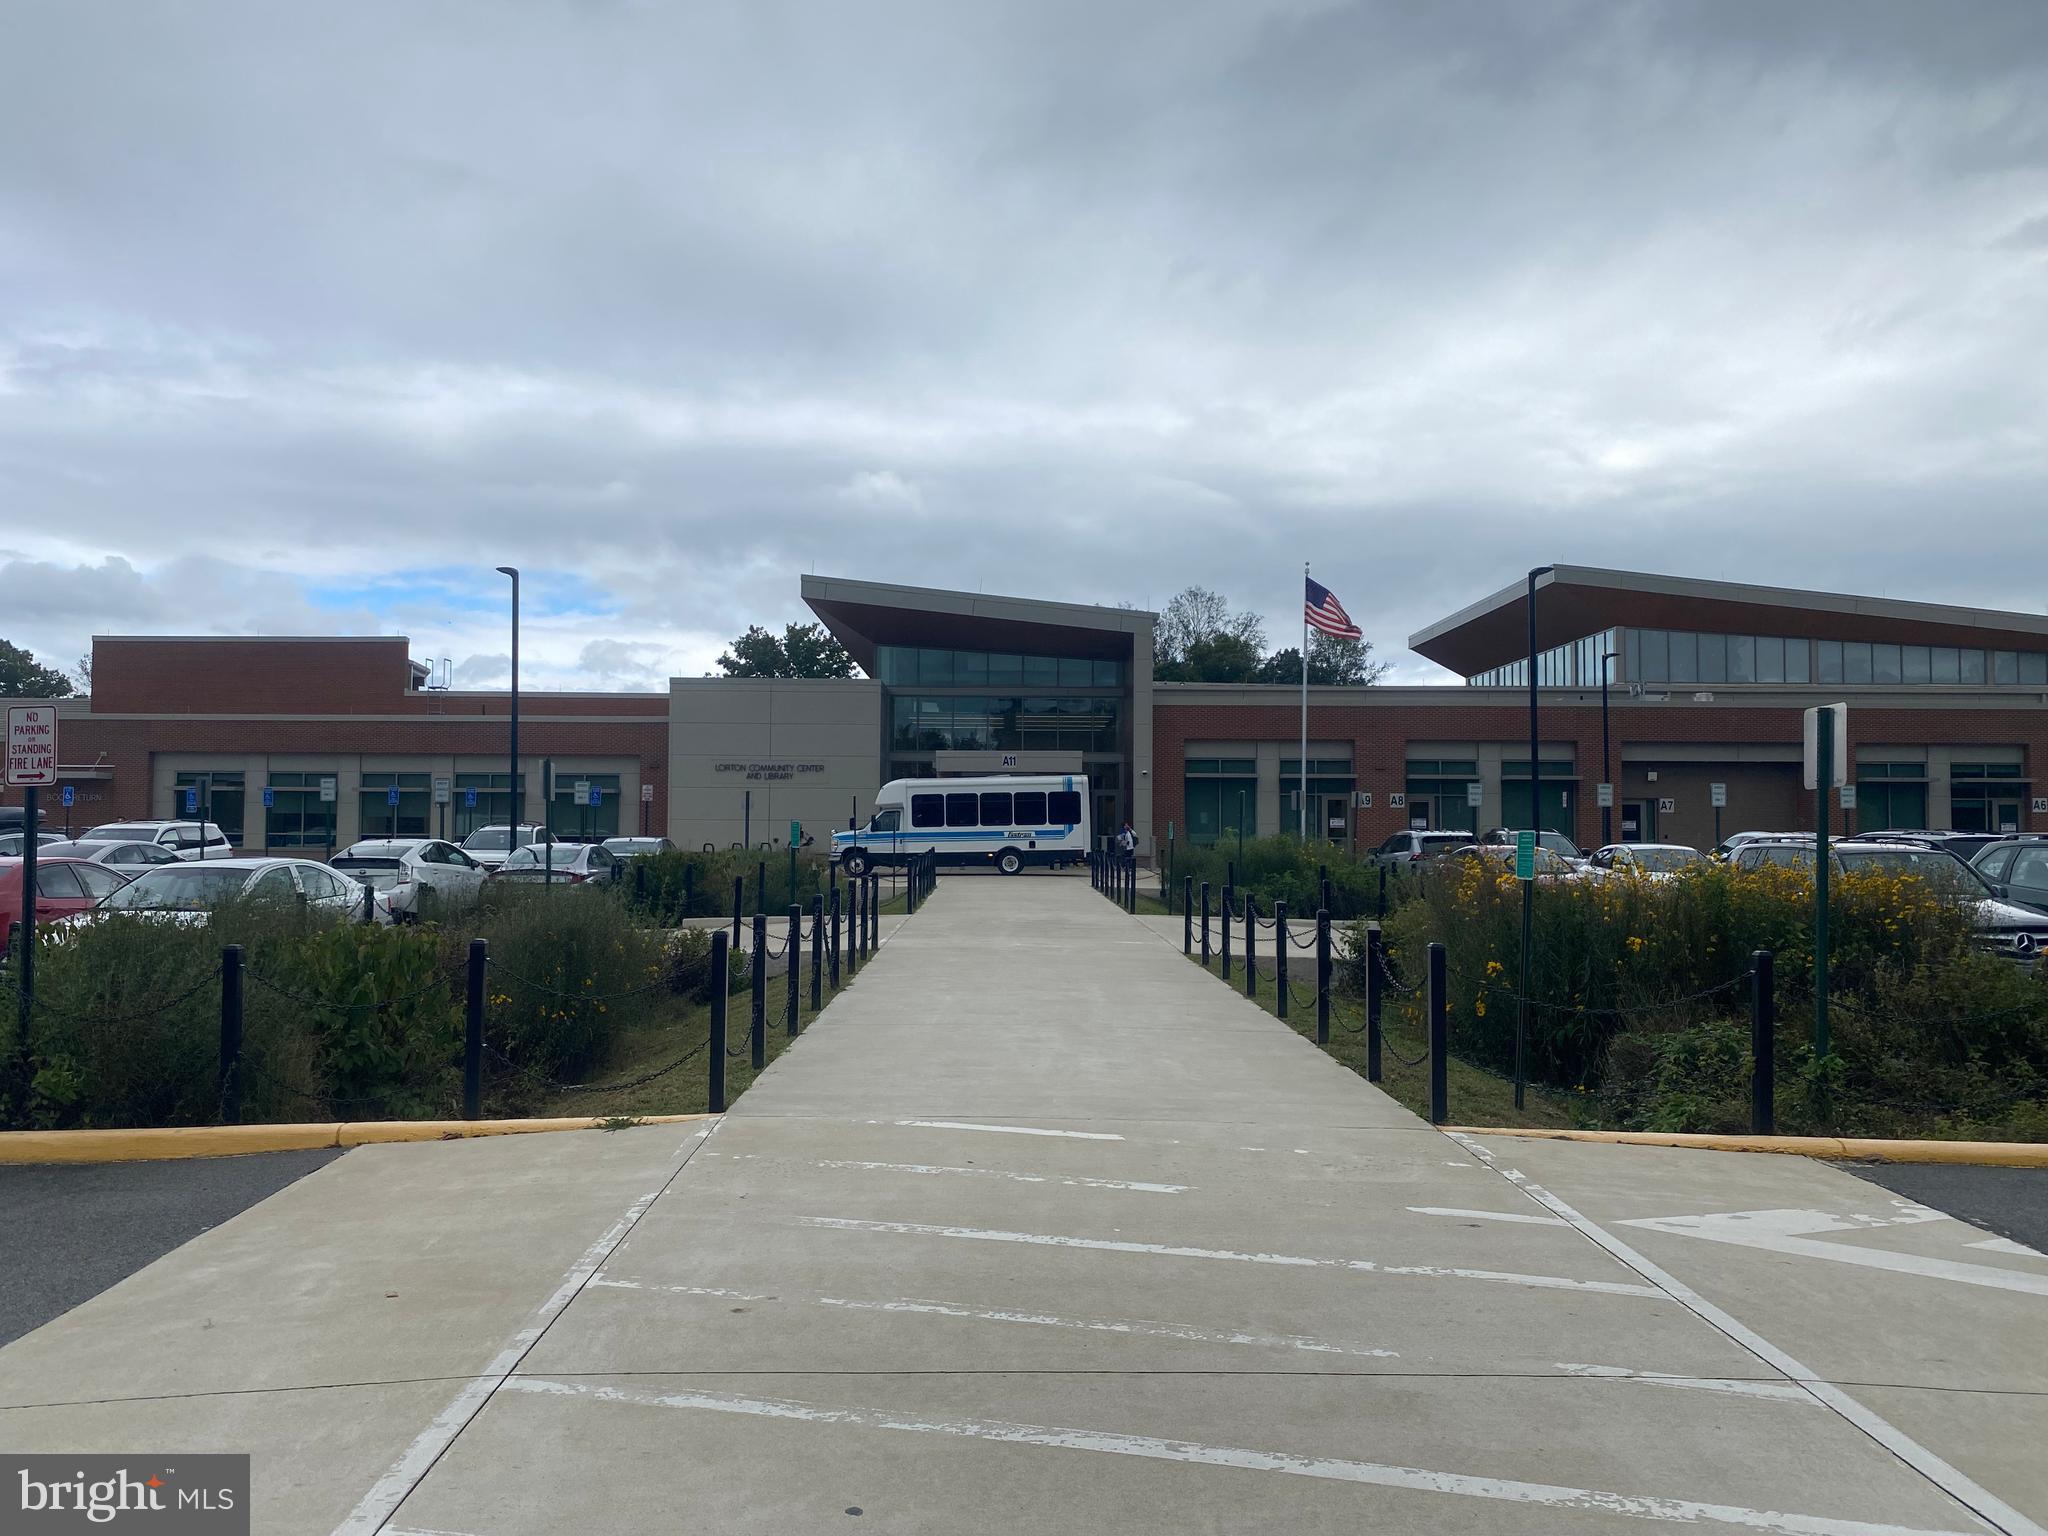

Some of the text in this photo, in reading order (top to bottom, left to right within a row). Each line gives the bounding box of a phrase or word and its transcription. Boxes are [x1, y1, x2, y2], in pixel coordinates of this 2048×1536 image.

[26, 712, 39, 722] NO
[14, 725, 50, 735] PARKING
[11, 744, 52, 755] STANDING
[9, 756, 54, 770] FIRE LANE
[1002, 756, 1016, 766] A11
[714, 764, 825, 772] LORTON COMMUNITY CENTER
[745, 772, 794, 780] AND LIBRARY
[1390, 795, 1404, 806] A8
[1660, 800, 1674, 811] A7
[2033, 800, 2047, 810] A6
